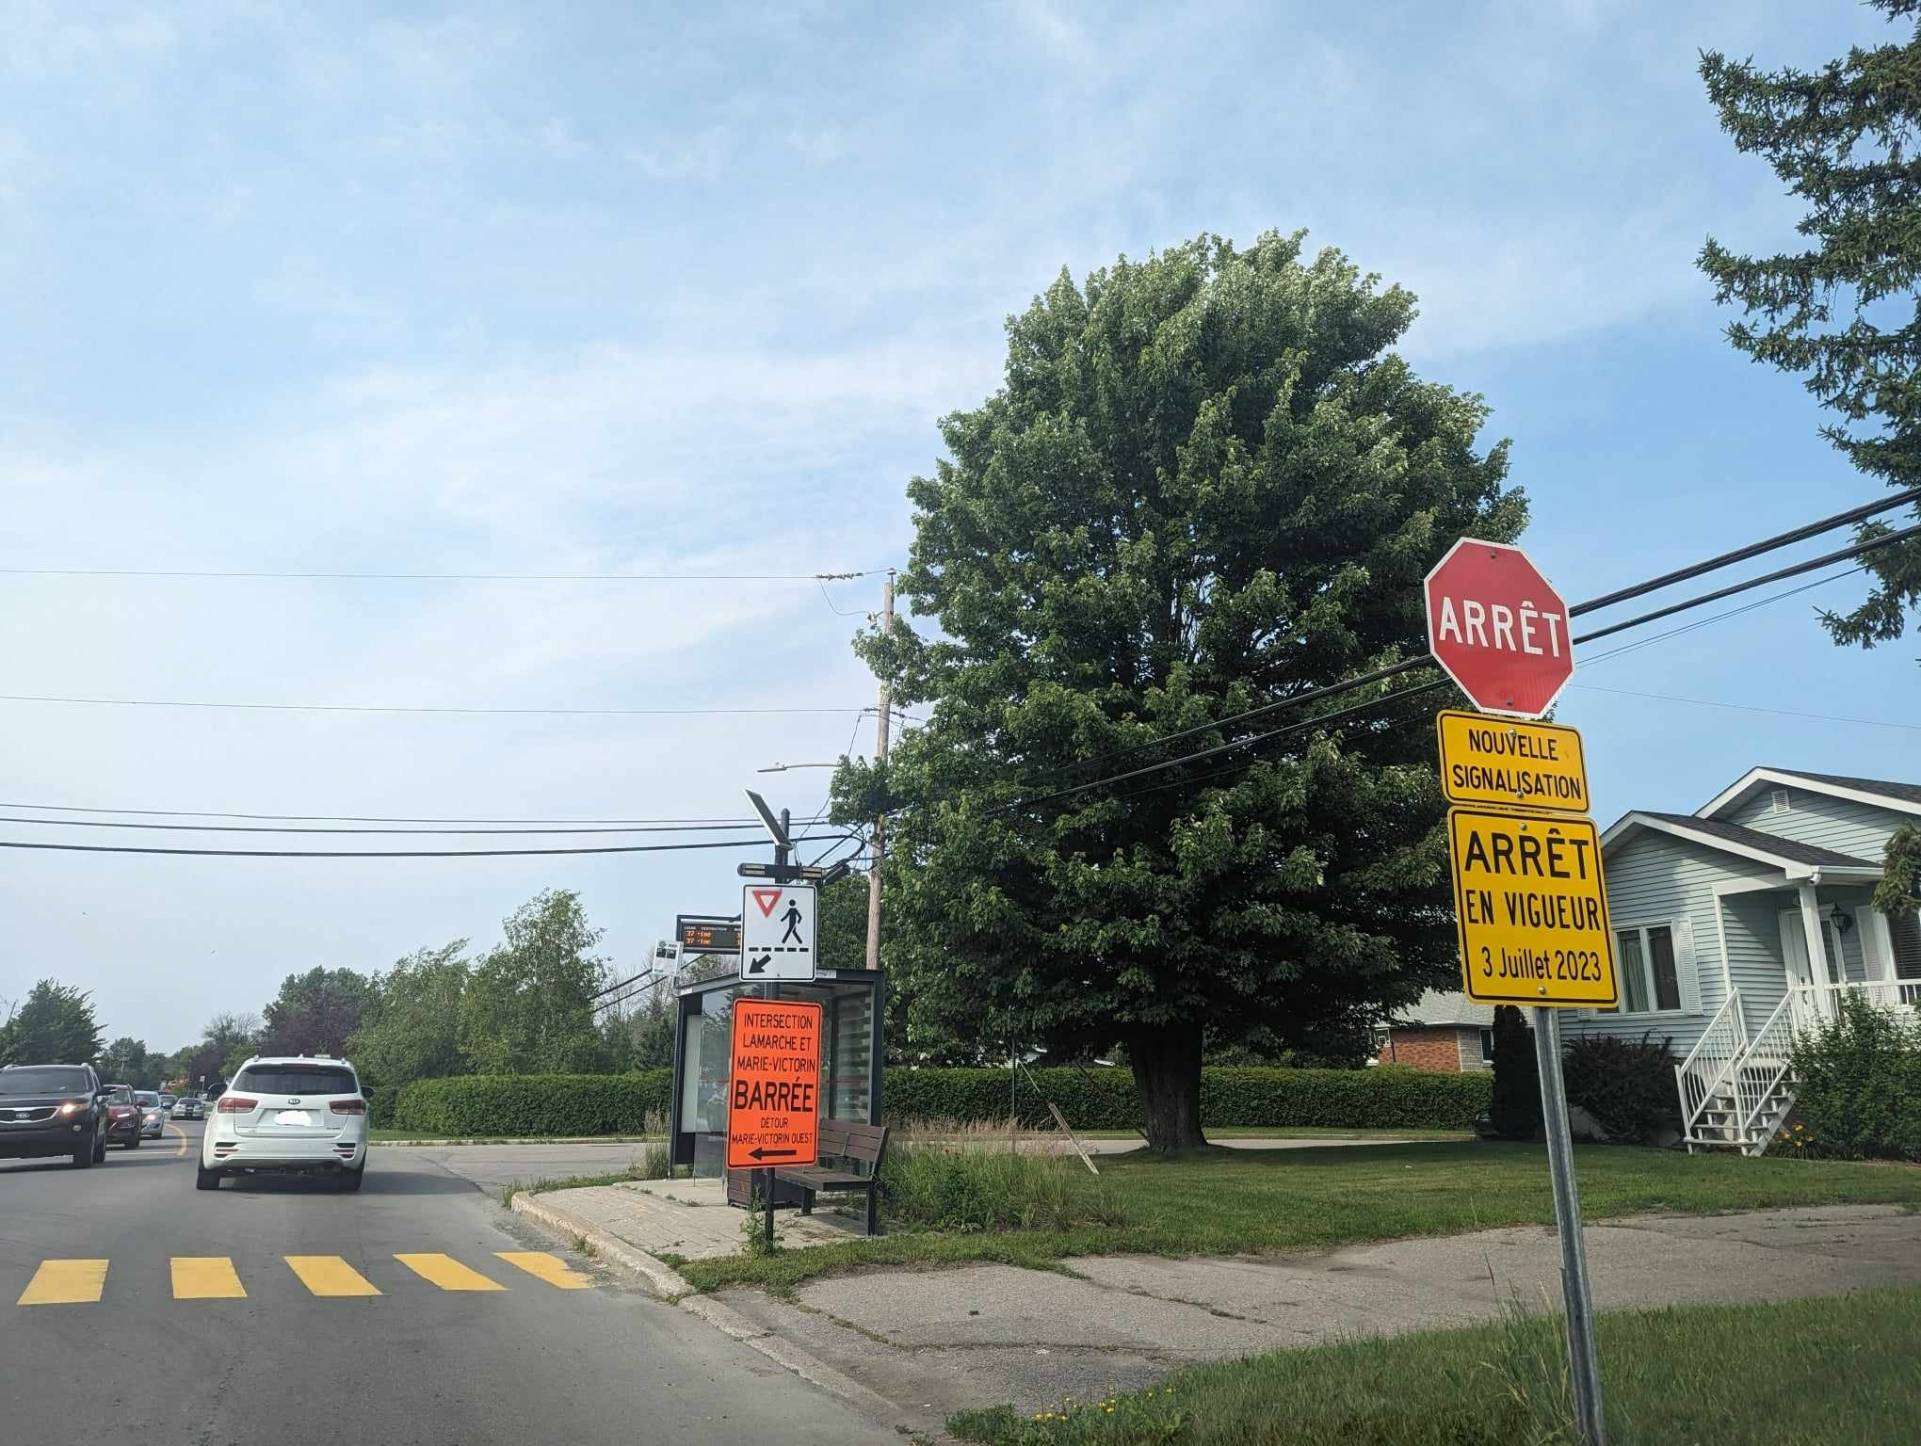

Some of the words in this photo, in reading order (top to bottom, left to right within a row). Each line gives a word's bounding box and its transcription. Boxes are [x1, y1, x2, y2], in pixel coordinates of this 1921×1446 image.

[1439, 596, 1561, 657] ARRÊT
[1468, 728, 1559, 761] NOUVELLE
[1453, 764, 1582, 800] SIGNALISATION
[1464, 828, 1589, 880] ARRÊT
[1466, 889, 1494, 925] EN
[1504, 891, 1601, 931] VIGUEUR
[1481, 946, 1493, 978] 3
[1499, 947, 1552, 980] Juillet
[1554, 949, 1602, 982] 2023
[744, 1013, 813, 1030] INTERSECTION
[743, 1033, 797, 1051] LAMARCHE
[800, 1037, 812, 1051] ET
[737, 1055, 816, 1073] MARIE-VICTORIN
[734, 1076, 814, 1112] BARRÉE
[732, 1132, 790, 1145] MARIE-VICTORIN
[791, 1133, 813, 1144] OUEST
